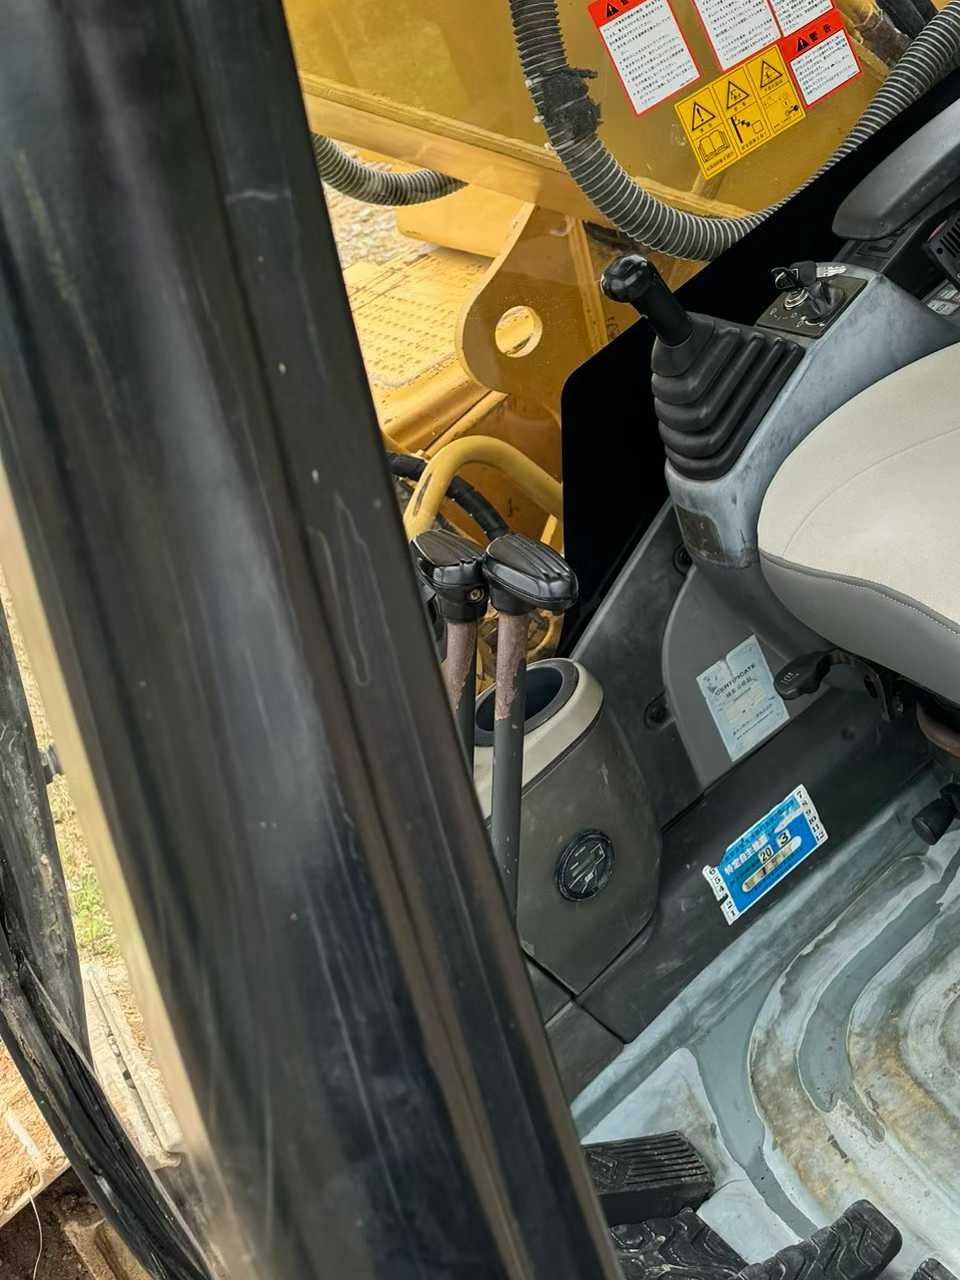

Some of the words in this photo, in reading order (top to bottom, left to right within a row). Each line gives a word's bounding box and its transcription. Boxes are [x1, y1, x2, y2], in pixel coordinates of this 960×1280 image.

[715, 663, 757, 696] CERTIFICATE
[760, 846, 773, 863] 20
[778, 833, 788, 846] 3
